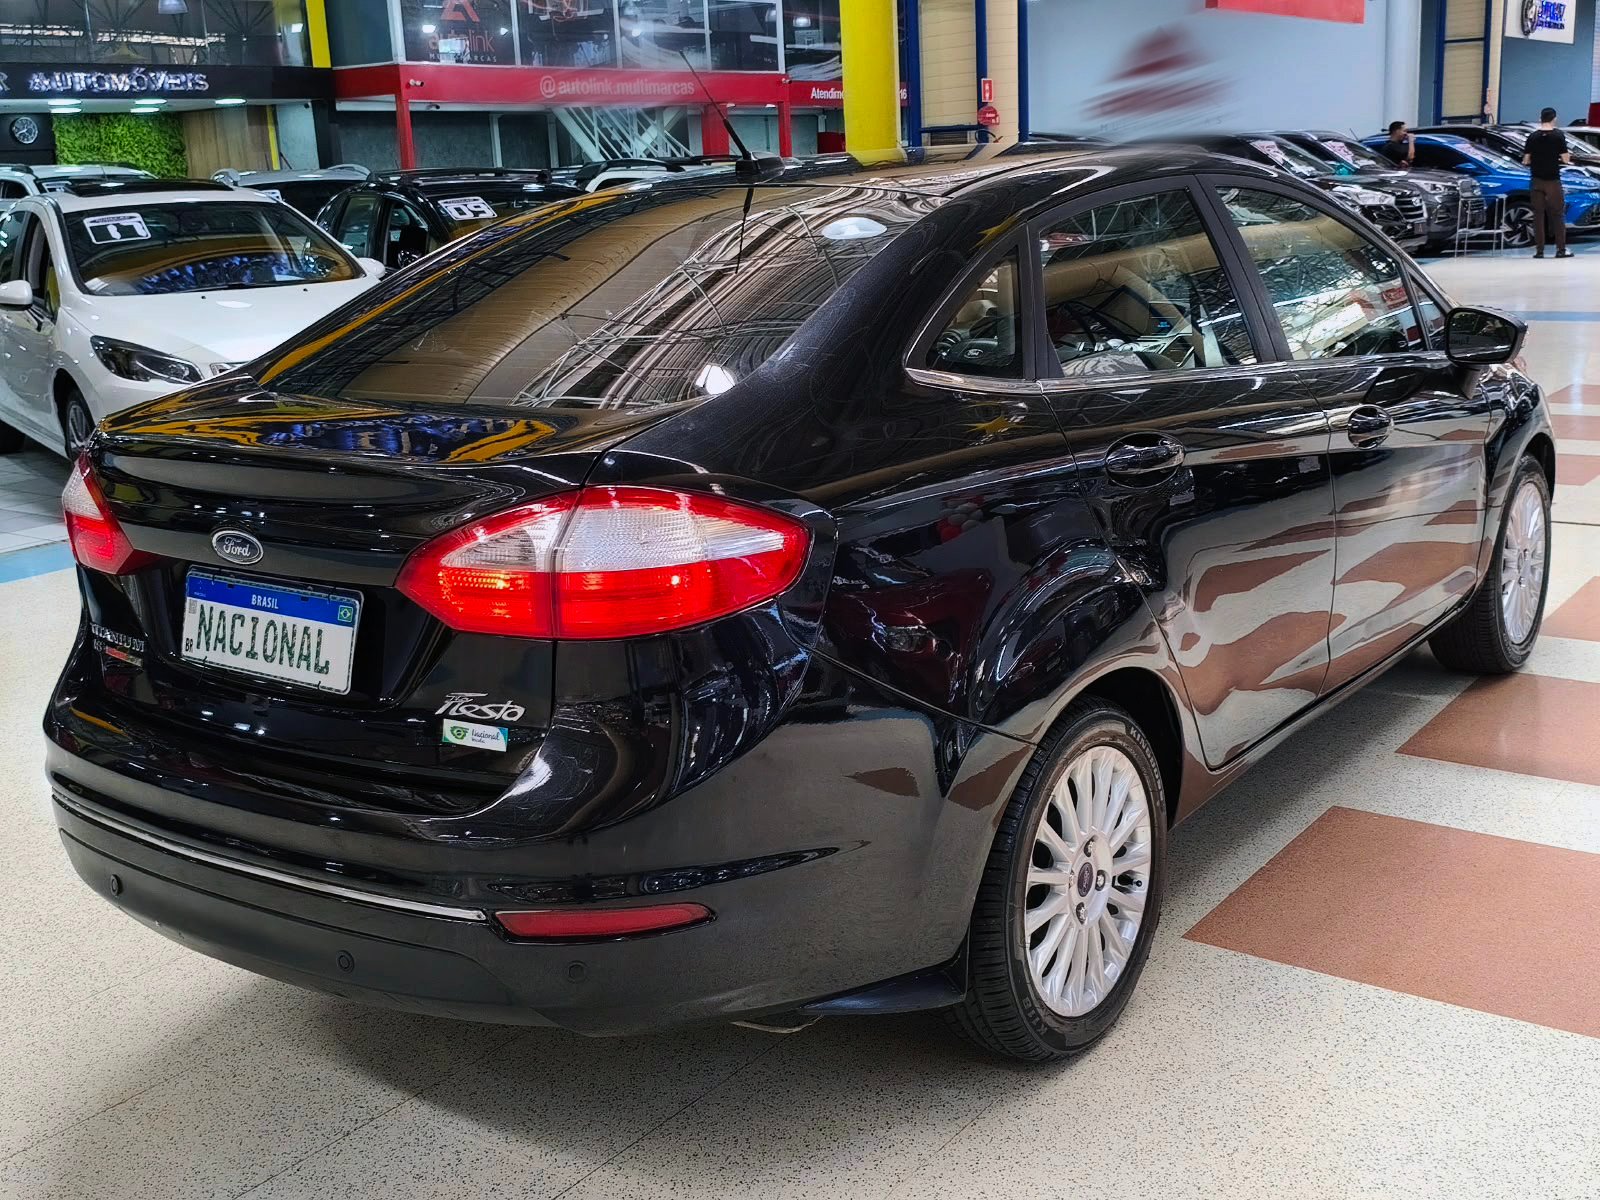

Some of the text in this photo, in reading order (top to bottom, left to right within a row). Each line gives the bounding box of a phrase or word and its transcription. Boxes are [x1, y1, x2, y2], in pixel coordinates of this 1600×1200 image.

[28, 67, 210, 92] AUTOMÓVEIS
[223, 537, 251, 557] Ford
[251, 594, 279, 610] BRASIL
[185, 637, 194, 654] BR
[196, 604, 330, 675] NACIONAL
[434, 692, 526, 722] Fiesta
